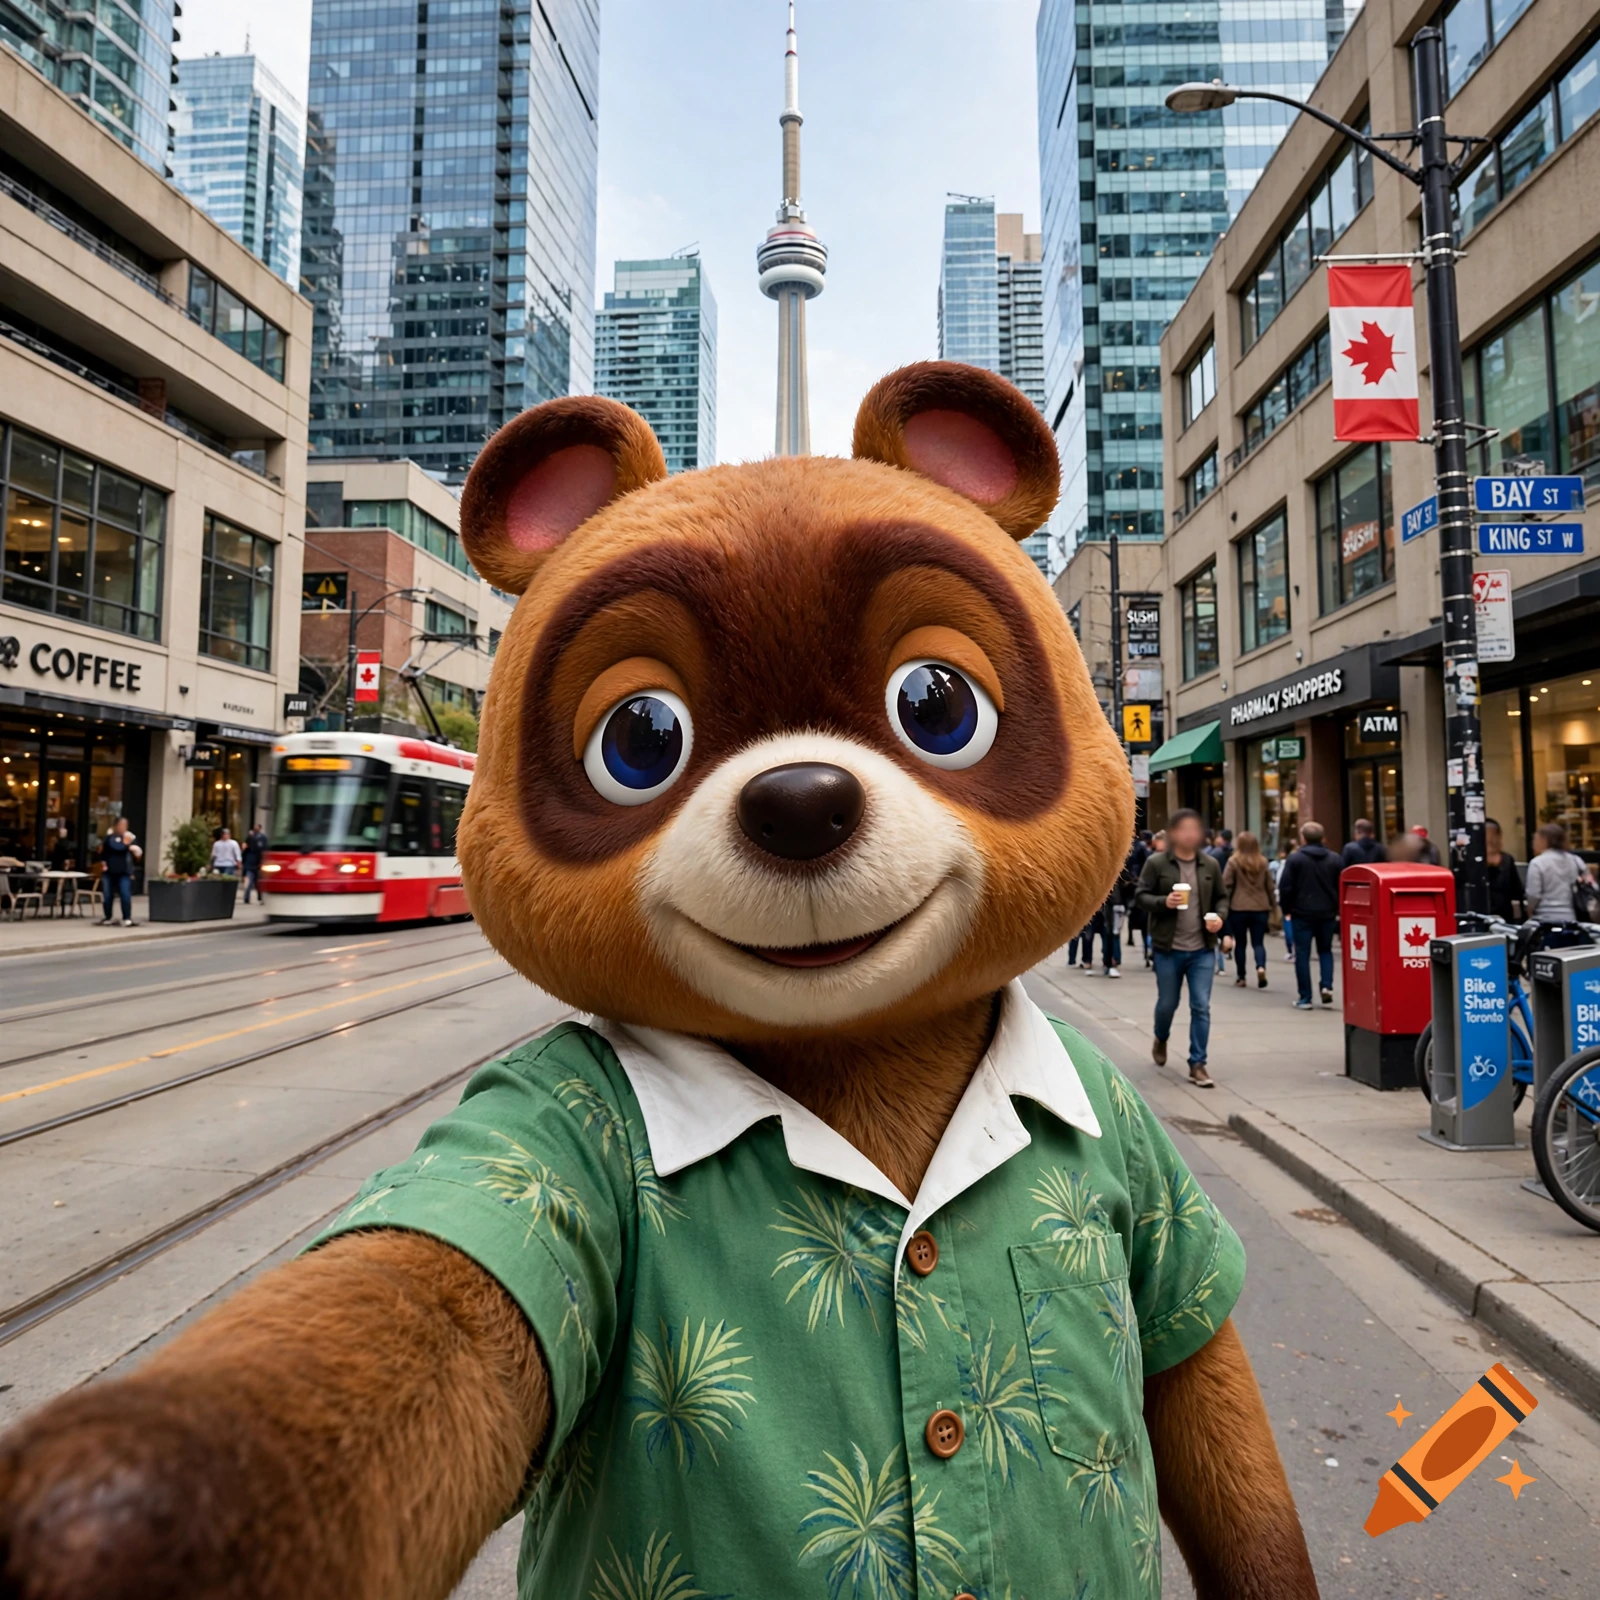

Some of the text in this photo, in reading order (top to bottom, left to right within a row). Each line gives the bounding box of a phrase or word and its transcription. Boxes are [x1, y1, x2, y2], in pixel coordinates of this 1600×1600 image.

[1491, 480, 1559, 508] BAY ST
[1406, 504, 1433, 535] BAY ST
[1489, 527, 1573, 550] KING ST W
[1127, 610, 1158, 623] SUSHI
[30, 642, 142, 691] COFFEE
[1230, 668, 1342, 726] PHARMACY SHOPPERS
[1363, 716, 1398, 732] ATM
[1403, 958, 1430, 969] POST
[1464, 978, 1496, 993] Bike
[1464, 995, 1505, 1010] Share
[1465, 1011, 1504, 1023] Toronto
[1577, 1004, 1600, 1022] Bik
[1577, 1024, 1600, 1042] Sh
